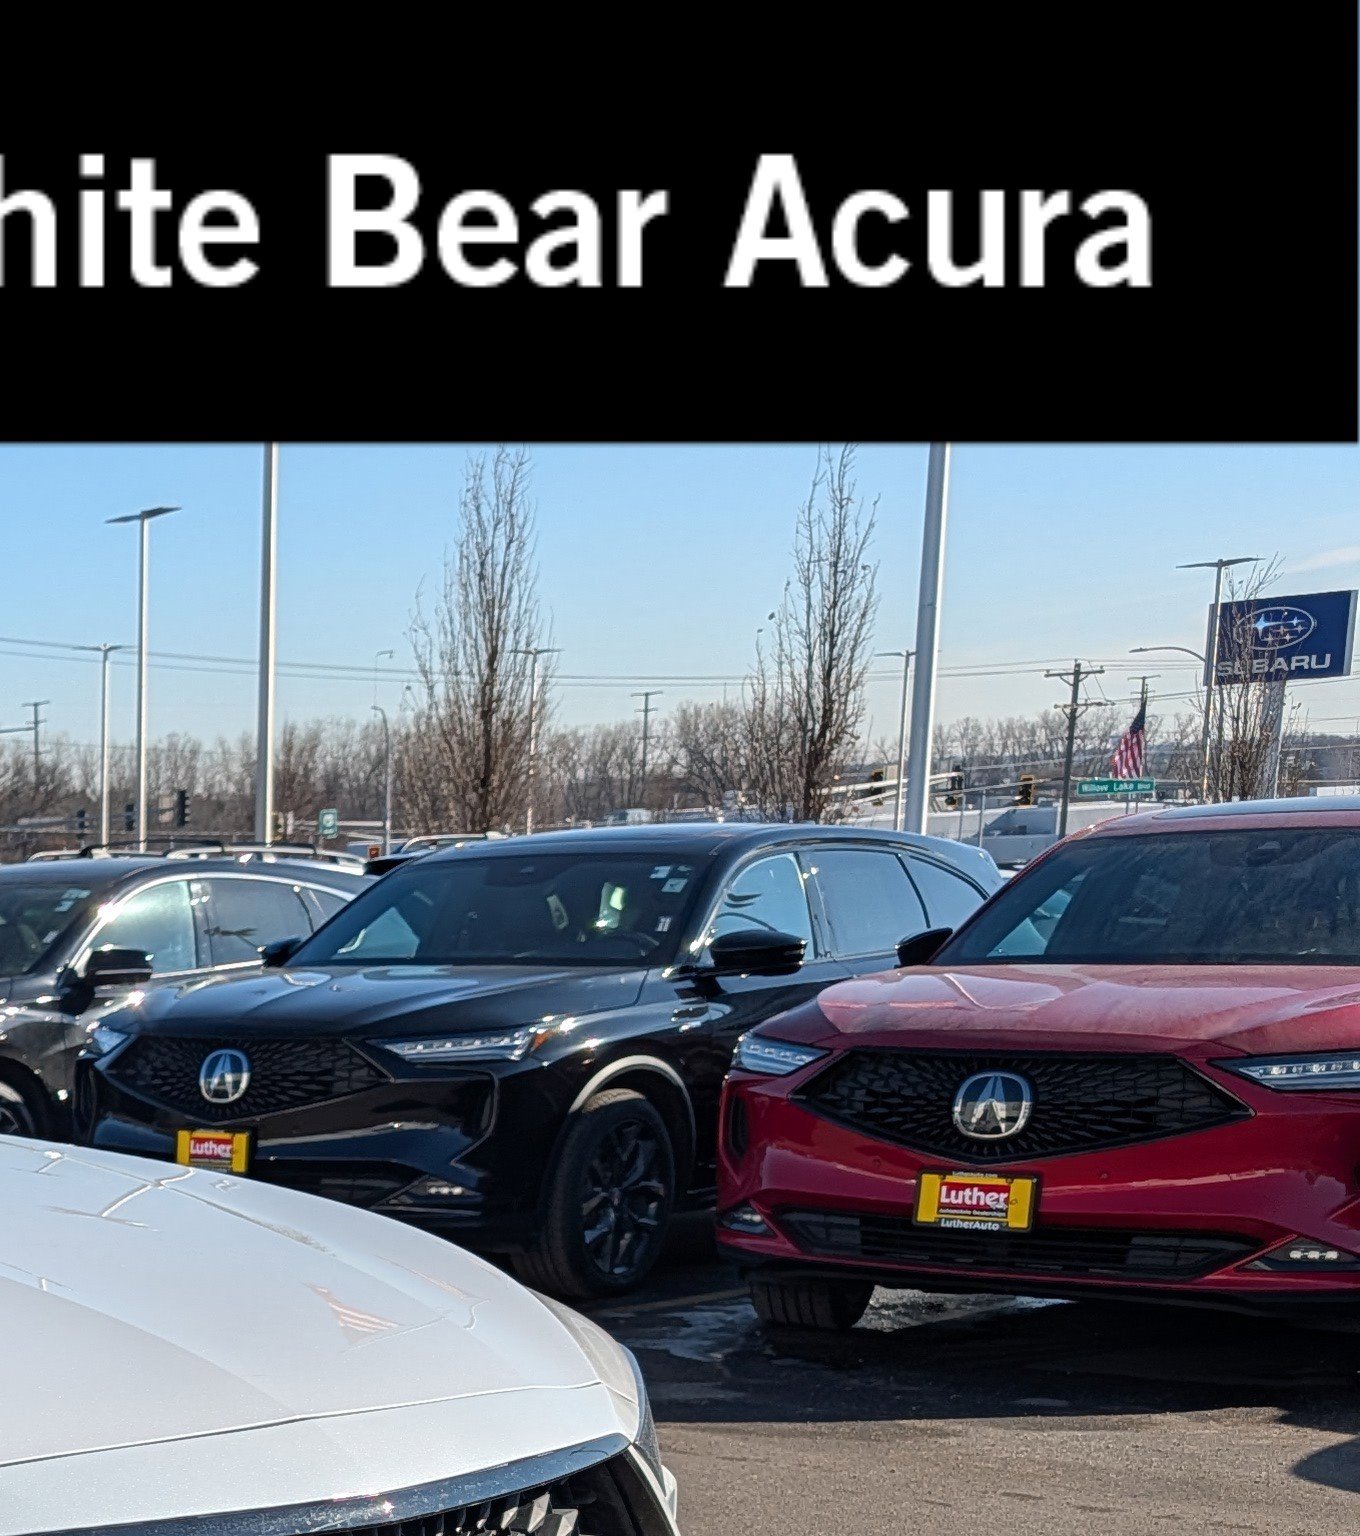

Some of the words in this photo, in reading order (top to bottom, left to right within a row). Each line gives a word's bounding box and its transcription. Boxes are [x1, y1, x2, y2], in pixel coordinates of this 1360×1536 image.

[1082, 783, 1109, 792] Willow
[1113, 782, 1134, 791] Lake
[190, 1140, 232, 1157] Luther
[940, 1185, 1008, 1209] Luther
[941, 1218, 1000, 1231] LutherAuto
